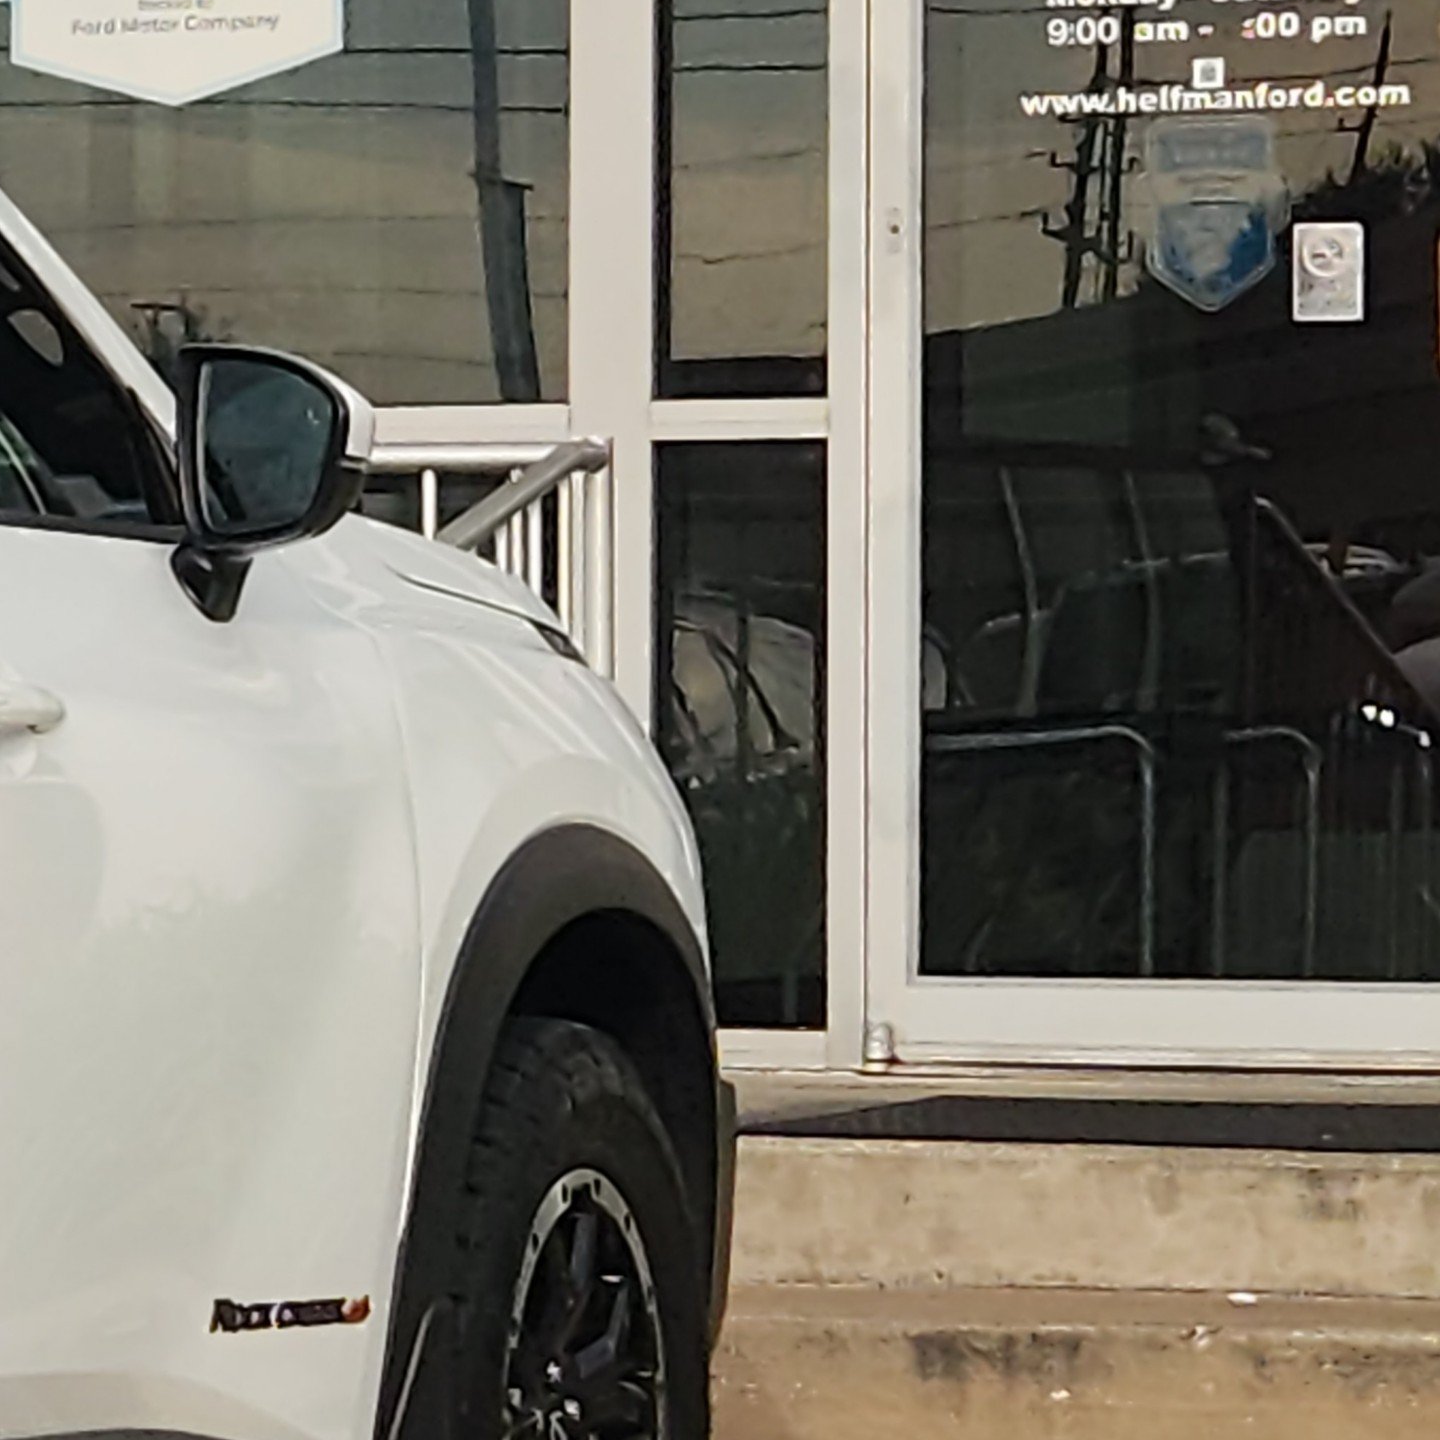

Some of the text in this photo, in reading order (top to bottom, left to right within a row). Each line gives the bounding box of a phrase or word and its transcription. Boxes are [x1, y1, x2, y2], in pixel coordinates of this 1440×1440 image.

[1046, 16, 1119, 46] 9:00
[1133, 20, 1190, 42] am
[1310, 16, 1368, 43] pm
[1020, 81, 1411, 116] www.helfmanford.com
